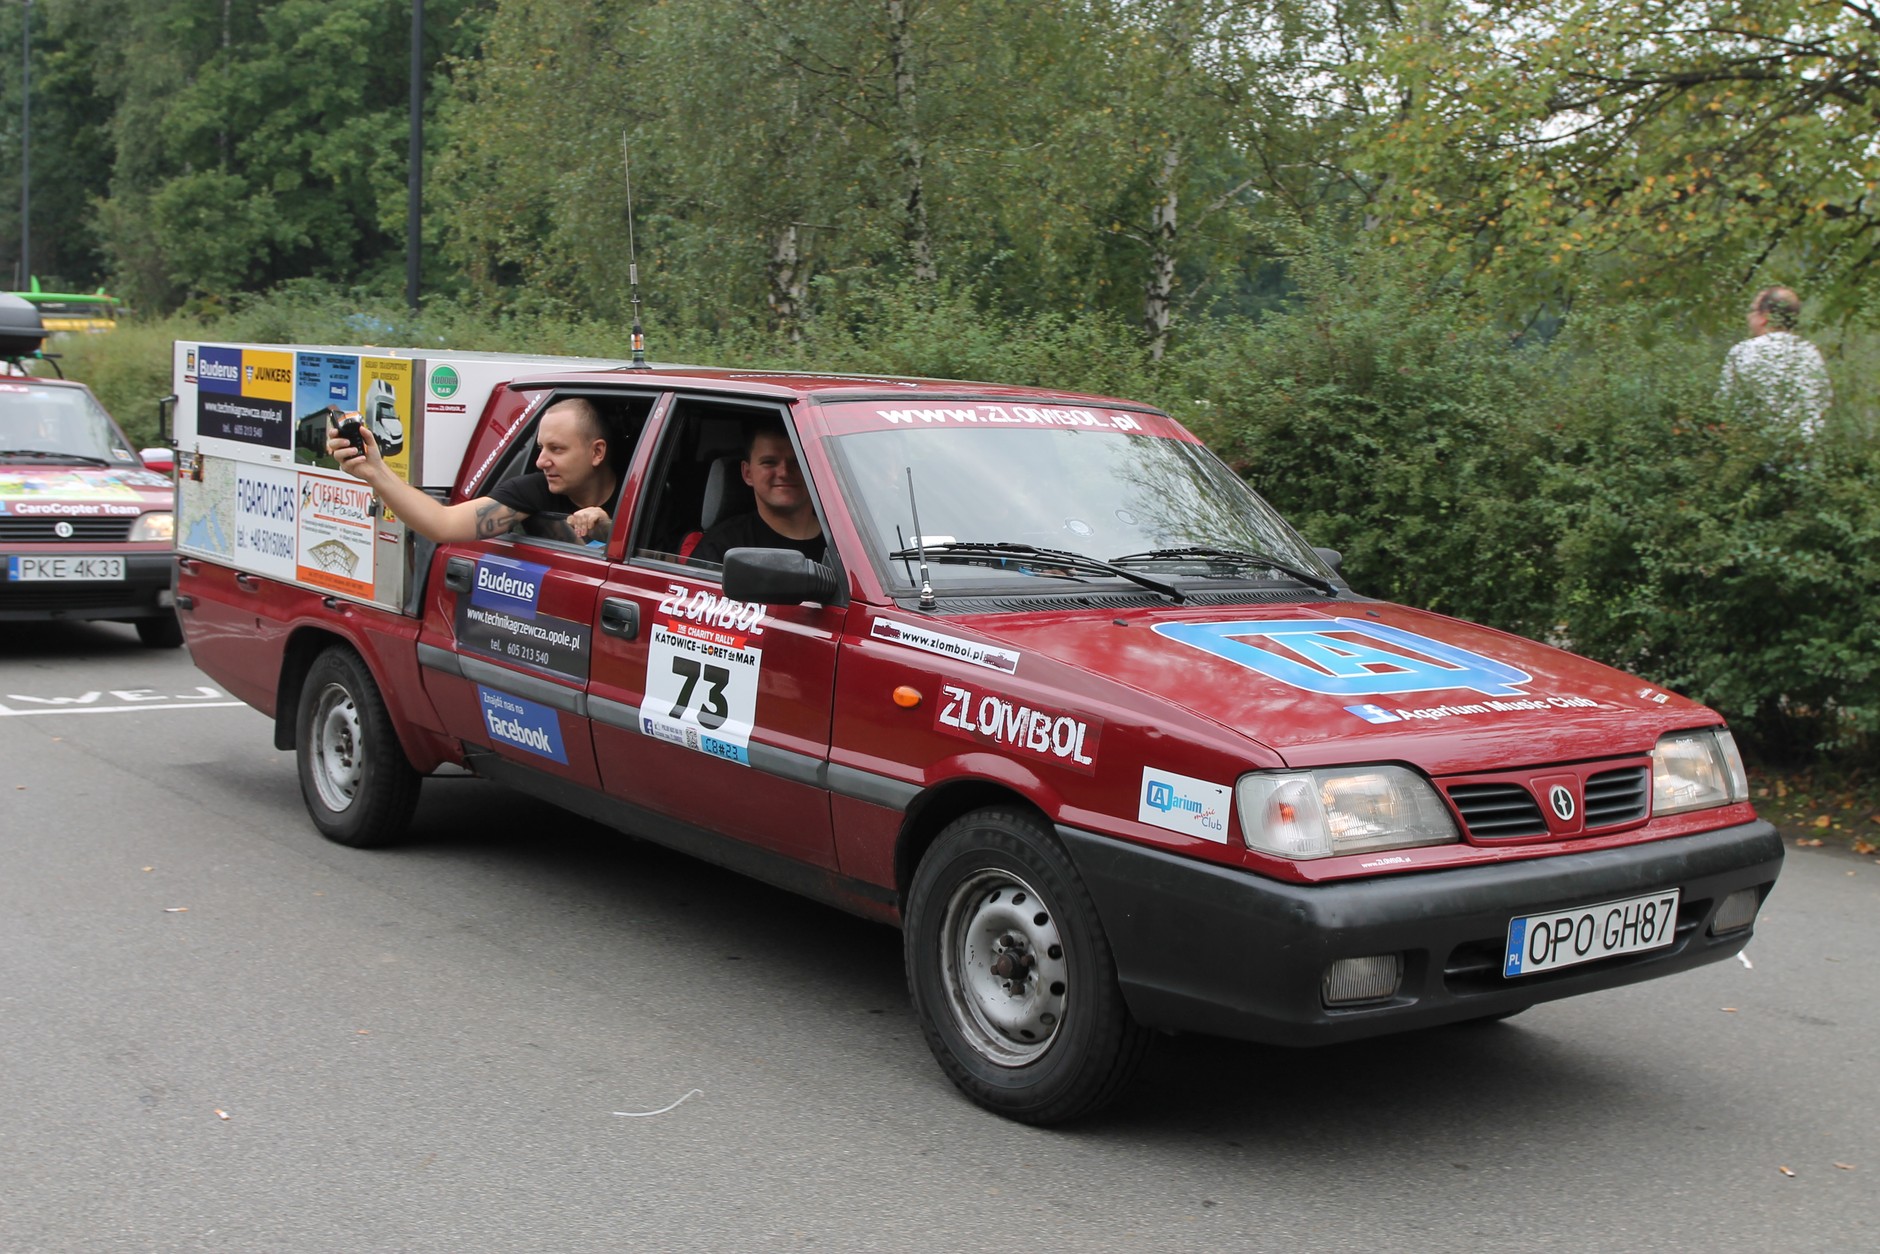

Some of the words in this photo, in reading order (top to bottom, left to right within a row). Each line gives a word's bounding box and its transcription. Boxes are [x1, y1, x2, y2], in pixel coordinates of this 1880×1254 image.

[199, 359, 238, 379] Buderus
[255, 367, 291, 383] JUNKERS
[876, 405, 1142, 431] www.ZLOMBOL.pl
[243, 425, 253, 437] 213
[15, 503, 99, 515] CaroCopter
[101, 504, 140, 515] Team
[238, 478, 269, 516] FIGARO
[271, 483, 295, 522] CARS
[312, 482, 374, 518] CIESIELSTWO
[22, 560, 66, 577] PKE
[74, 560, 120, 577] 4K33
[478, 567, 534, 598] Buderus
[467, 608, 581, 650] www.technikagrzewcza.opole.pl
[677, 624, 687, 632] THE
[687, 626, 715, 641] CHARITY
[715, 634, 736, 645] RALLY
[491, 638, 502, 651] tel.
[507, 643, 520, 657] 605
[521, 646, 534, 661] 213
[536, 650, 549, 665] 540
[902, 631, 983, 661] www.zlombol.pl
[735, 652, 755, 666] MAR
[669, 655, 730, 730] 73
[503, 701, 514, 713] nas
[515, 704, 524, 715] na
[1395, 704, 1490, 721] Aqarium
[1482, 698, 1551, 712] Music
[1547, 697, 1599, 708] Club
[487, 709, 552, 753] facebook
[939, 684, 1093, 765] ZLOMBOL
[1201, 817, 1222, 831] Club
[1528, 913, 1595, 965] OPO
[1603, 897, 1675, 951] GH87
[1508, 953, 1520, 966] PL
